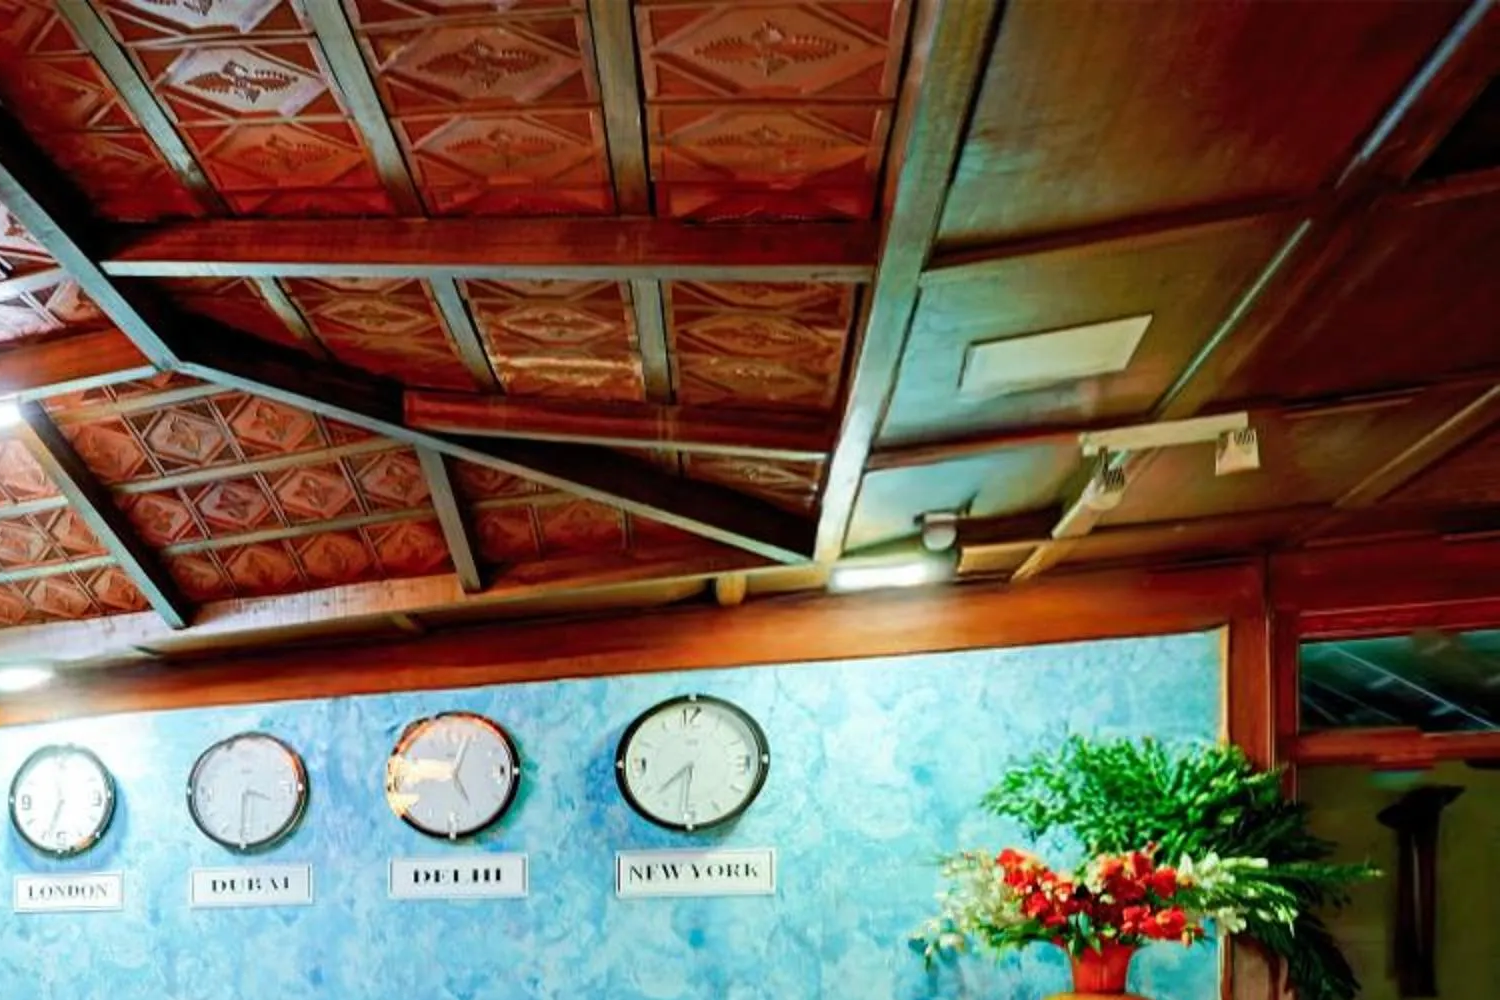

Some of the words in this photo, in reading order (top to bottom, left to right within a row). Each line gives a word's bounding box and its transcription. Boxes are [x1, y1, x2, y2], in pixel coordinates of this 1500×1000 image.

[413, 869, 501, 883] DELHI
[629, 864, 682, 881] NEW
[692, 861, 758, 880] YORK
[28, 884, 108, 900] LONDON
[212, 877, 289, 893] DUBAI
